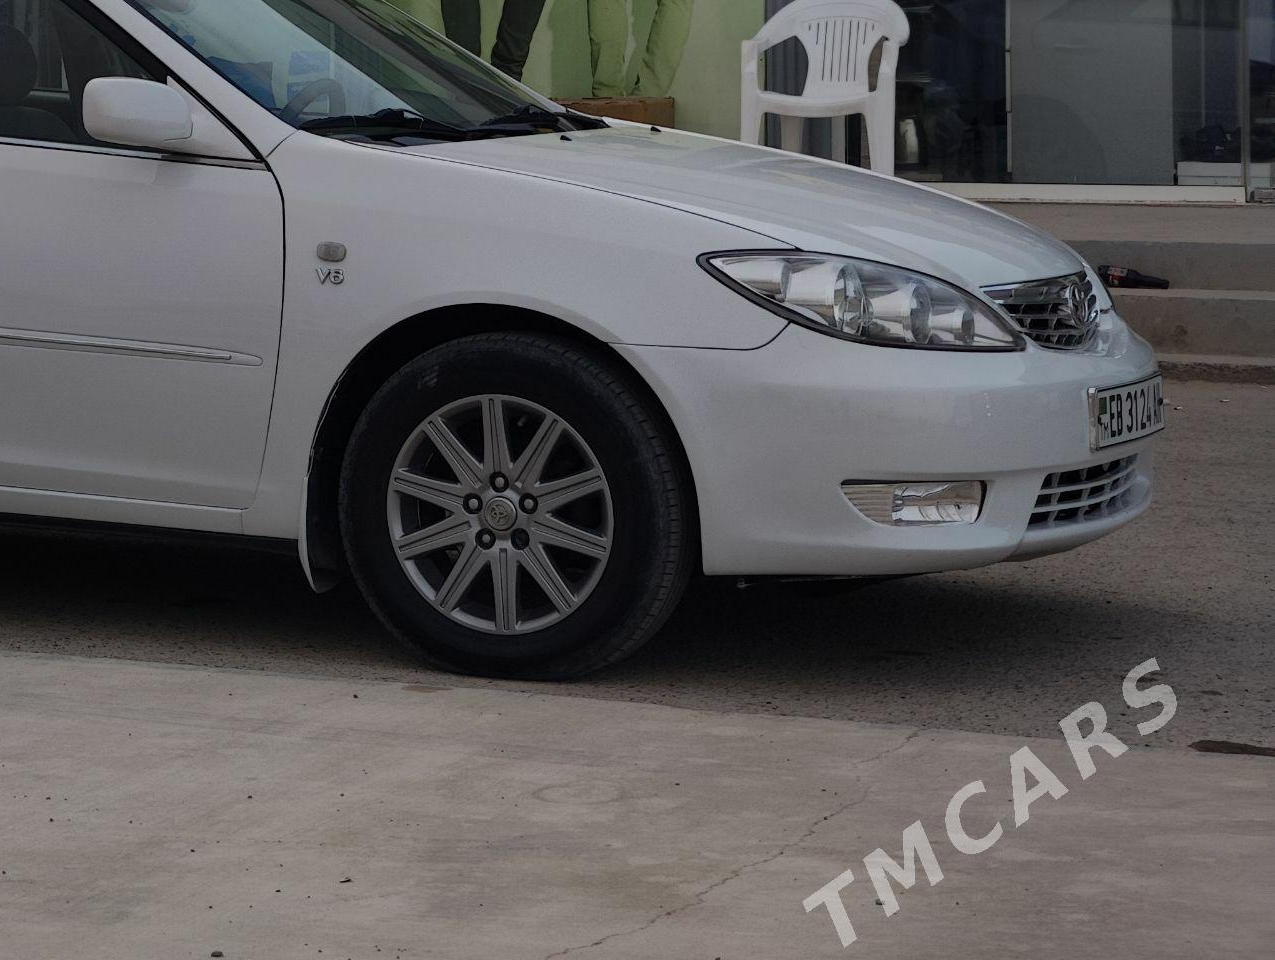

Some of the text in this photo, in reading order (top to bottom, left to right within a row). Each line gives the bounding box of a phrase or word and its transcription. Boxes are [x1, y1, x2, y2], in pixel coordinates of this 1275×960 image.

[315, 268, 345, 285] V6
[1109, 393, 1124, 438] EB
[1125, 385, 1152, 434] 3124
